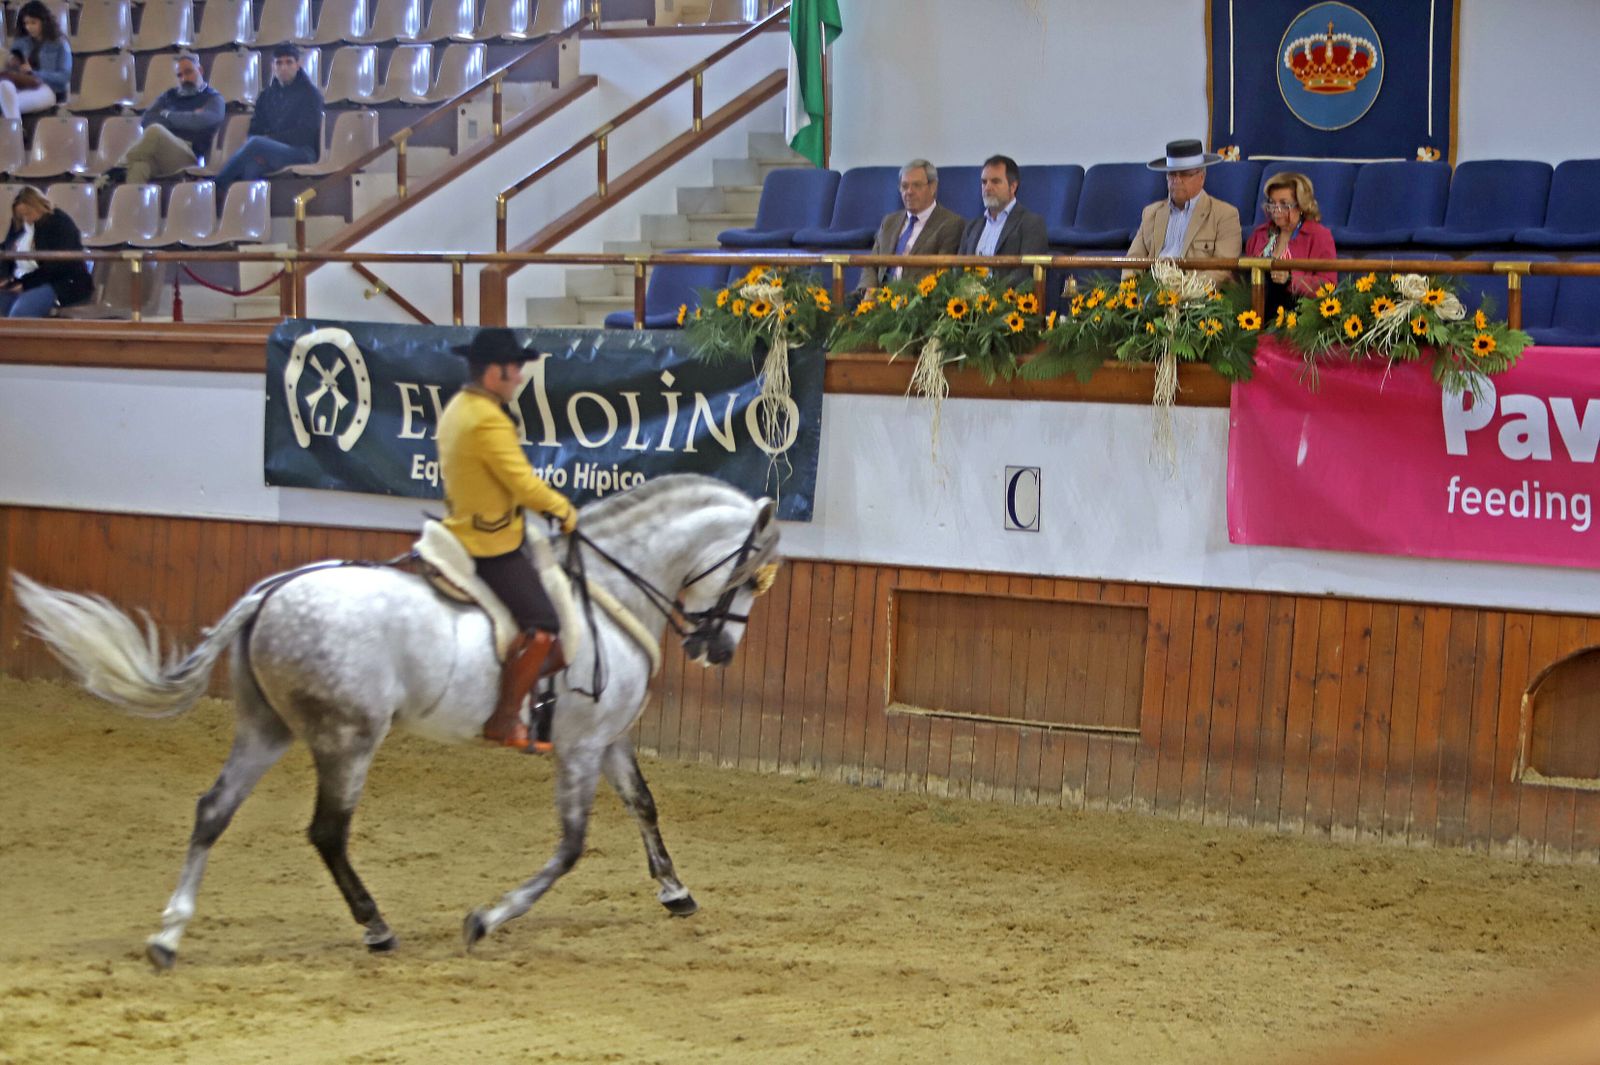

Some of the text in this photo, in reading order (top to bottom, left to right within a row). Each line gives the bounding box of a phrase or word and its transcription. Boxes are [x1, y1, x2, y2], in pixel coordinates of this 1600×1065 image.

[573, 462, 646, 497] Hípico
[1007, 468, 1038, 529] C
[1447, 475, 1592, 532] feeding
